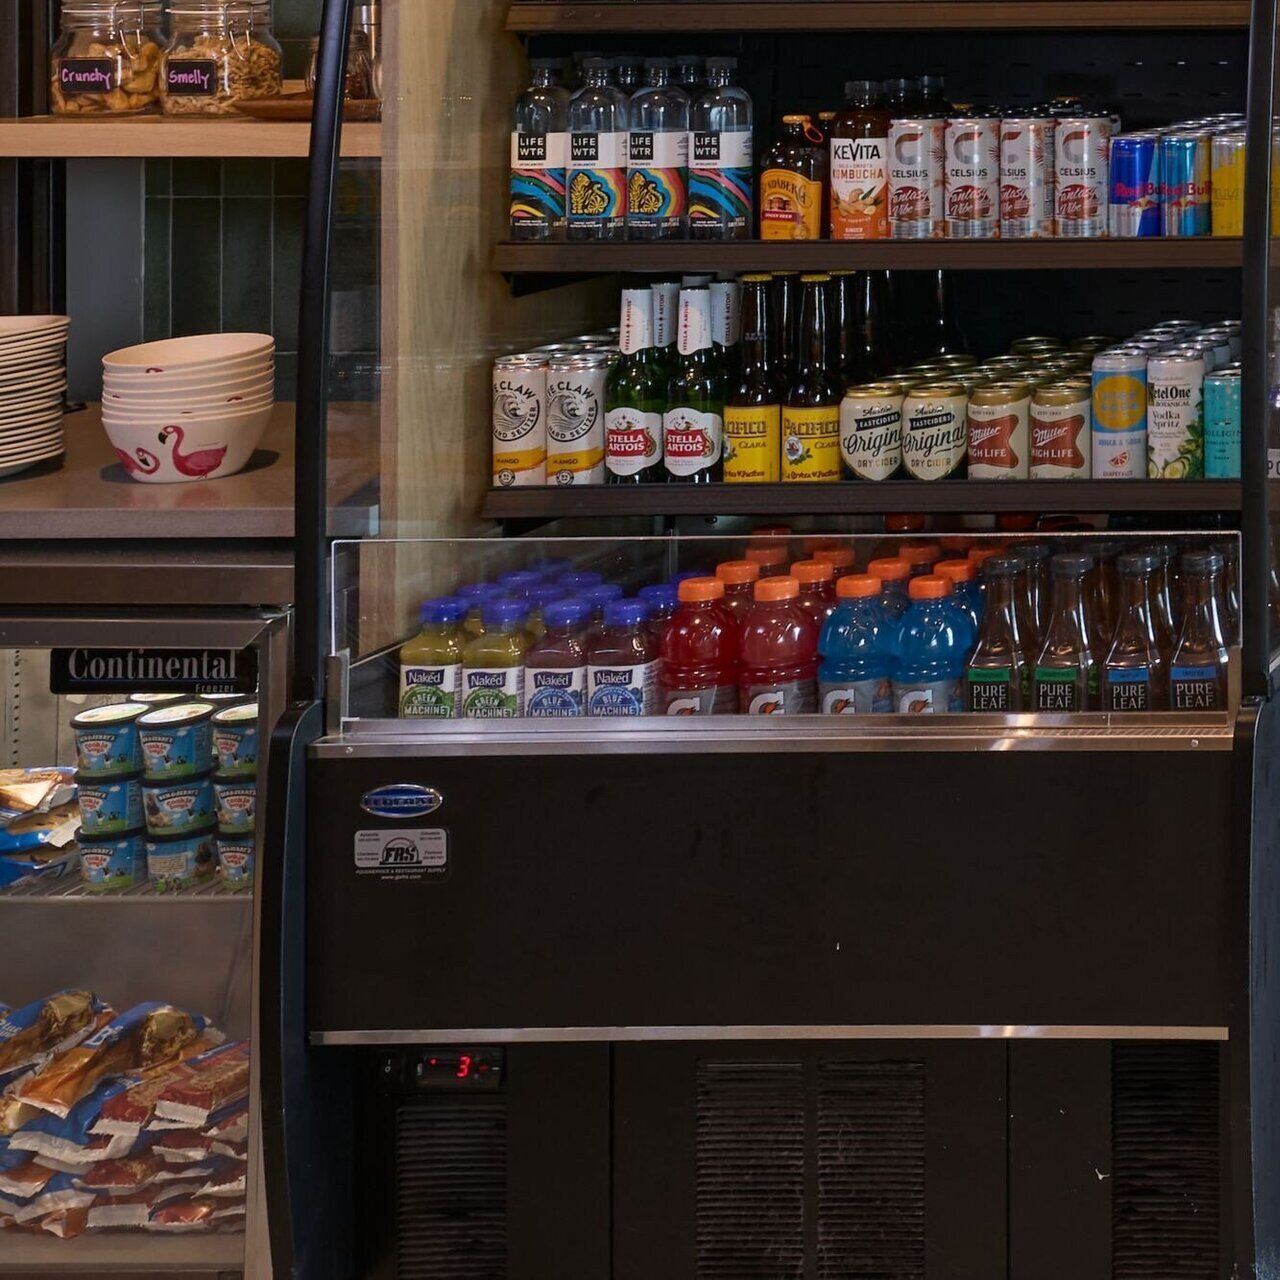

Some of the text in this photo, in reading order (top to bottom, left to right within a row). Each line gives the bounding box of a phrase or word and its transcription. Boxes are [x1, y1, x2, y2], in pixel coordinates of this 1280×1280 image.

[61, 66, 115, 90] Crunchy
[168, 68, 210, 90] Smelly
[519, 137, 544, 147] LIFE
[572, 137, 597, 147] LIFE
[629, 137, 651, 147] LIFE
[695, 137, 717, 147] LIFE
[519, 147, 545, 157] WTR
[572, 147, 597, 157] WTR
[630, 147, 651, 157] WTR
[694, 147, 718, 157] WTR
[832, 169, 884, 180] KOMBUCHA
[891, 170, 928, 179] CELSIUS
[950, 168, 988, 177] CELSIUS
[1000, 168, 1027, 176] ELSIUS
[1059, 167, 1096, 176] CELSIUS
[499, 380, 536, 400] CLAW
[557, 380, 596, 400] CLAW
[1153, 386, 1191, 400] etel One
[862, 403, 893, 417] Austin
[914, 403, 945, 417] Austin
[1152, 410, 1181, 420] Vodka
[511, 406, 538, 440] SELTZER
[570, 406, 596, 440] SELTZER
[1152, 419, 1180, 430] Spritz
[608, 434, 645, 443] STELLA
[667, 434, 704, 443] STELLA
[903, 421, 968, 458] Original
[969, 426, 1001, 445] Miller
[1033, 426, 1069, 447] Miller
[608, 442, 645, 452] ARTOIS
[667, 442, 704, 452] ARTOIS
[985, 448, 1007, 458] LIFE
[1051, 448, 1073, 458] LIFE
[857, 459, 873, 468] DRY
[911, 458, 925, 468] DRY
[68, 648, 237, 680] Continental
[408, 671, 442, 683] Naked
[470, 673, 504, 686] Naked
[537, 672, 569, 685] Naked
[597, 671, 629, 684] Naked
[195, 683, 235, 694] Freezer
[973, 685, 1007, 698] PURE
[1039, 683, 1073, 697] PURE
[1112, 684, 1146, 698] PURE
[1176, 682, 1214, 696] PURE
[411, 695, 438, 704] GREEN
[476, 698, 499, 708] GREEN
[543, 697, 563, 706] BLUE
[973, 696, 1006, 710] LEAF
[1039, 695, 1072, 709] LEAF
[1112, 696, 1146, 710] LEAF
[1176, 695, 1214, 709] LEAF
[404, 704, 447, 715] MACHINE
[467, 707, 509, 718] MACHINE
[532, 707, 575, 717] MACHINE
[593, 705, 636, 716] MACHINE
[384, 847, 417, 862] FRS
